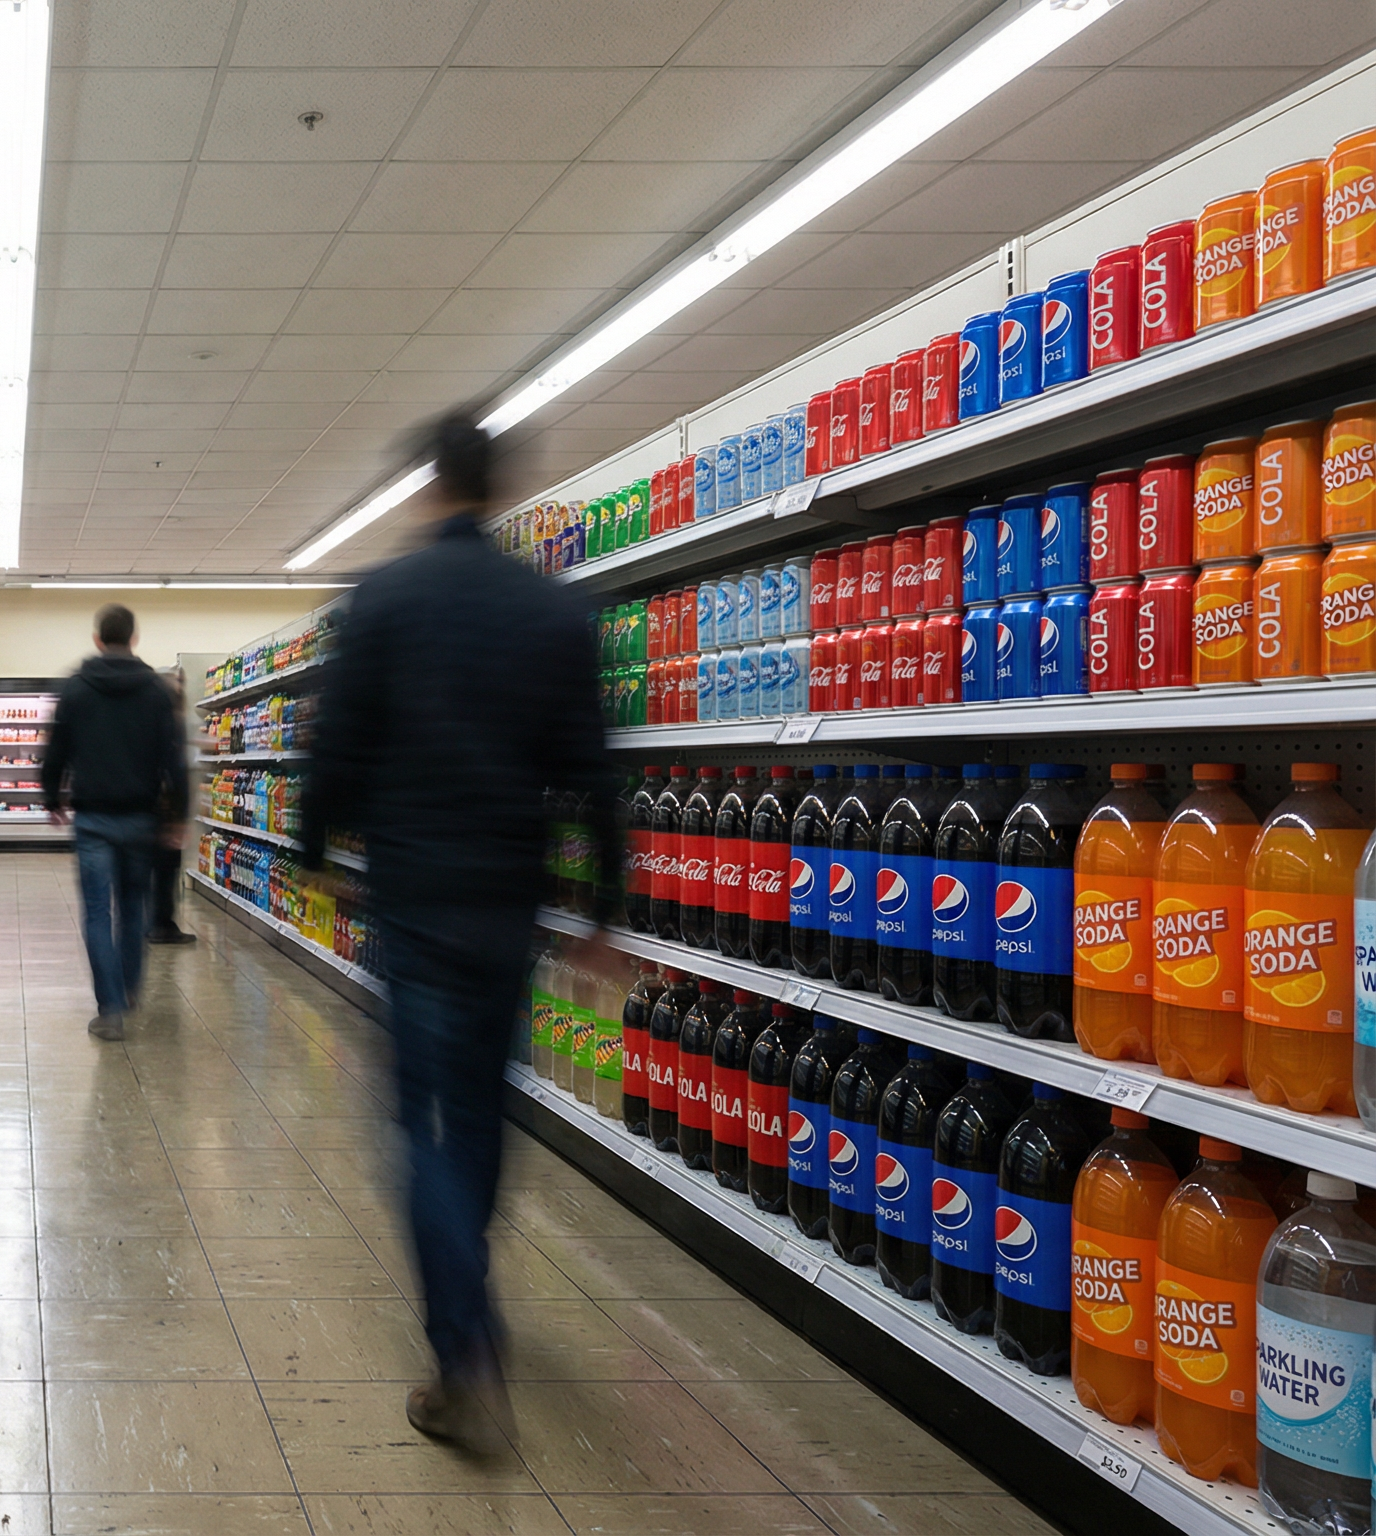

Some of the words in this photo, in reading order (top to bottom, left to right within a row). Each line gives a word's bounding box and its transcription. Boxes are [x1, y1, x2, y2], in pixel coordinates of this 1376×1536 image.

[1143, 251, 1167, 328] COLA
[1091, 275, 1114, 350] COLA
[1260, 449, 1283, 526] COLA
[1324, 462, 1374, 493] SODA
[1140, 479, 1159, 550] COLA
[1196, 494, 1242, 521] SODA
[1090, 492, 1108, 560] COLA
[1258, 581, 1281, 659] COLA
[1324, 602, 1375, 630] SODA
[1091, 608, 1108, 675] COLA
[1138, 600, 1154, 670] COLA
[1195, 619, 1243, 645] SODA
[1075, 923, 1126, 947] SODA
[1156, 935, 1212, 959] SODA
[1244, 921, 1334, 952] ORANGE
[1250, 949, 1317, 975] SODA
[1075, 1277, 1125, 1303] SODA
[1159, 1320, 1218, 1350] SODA
[1259, 1364, 1320, 1407] WATER
